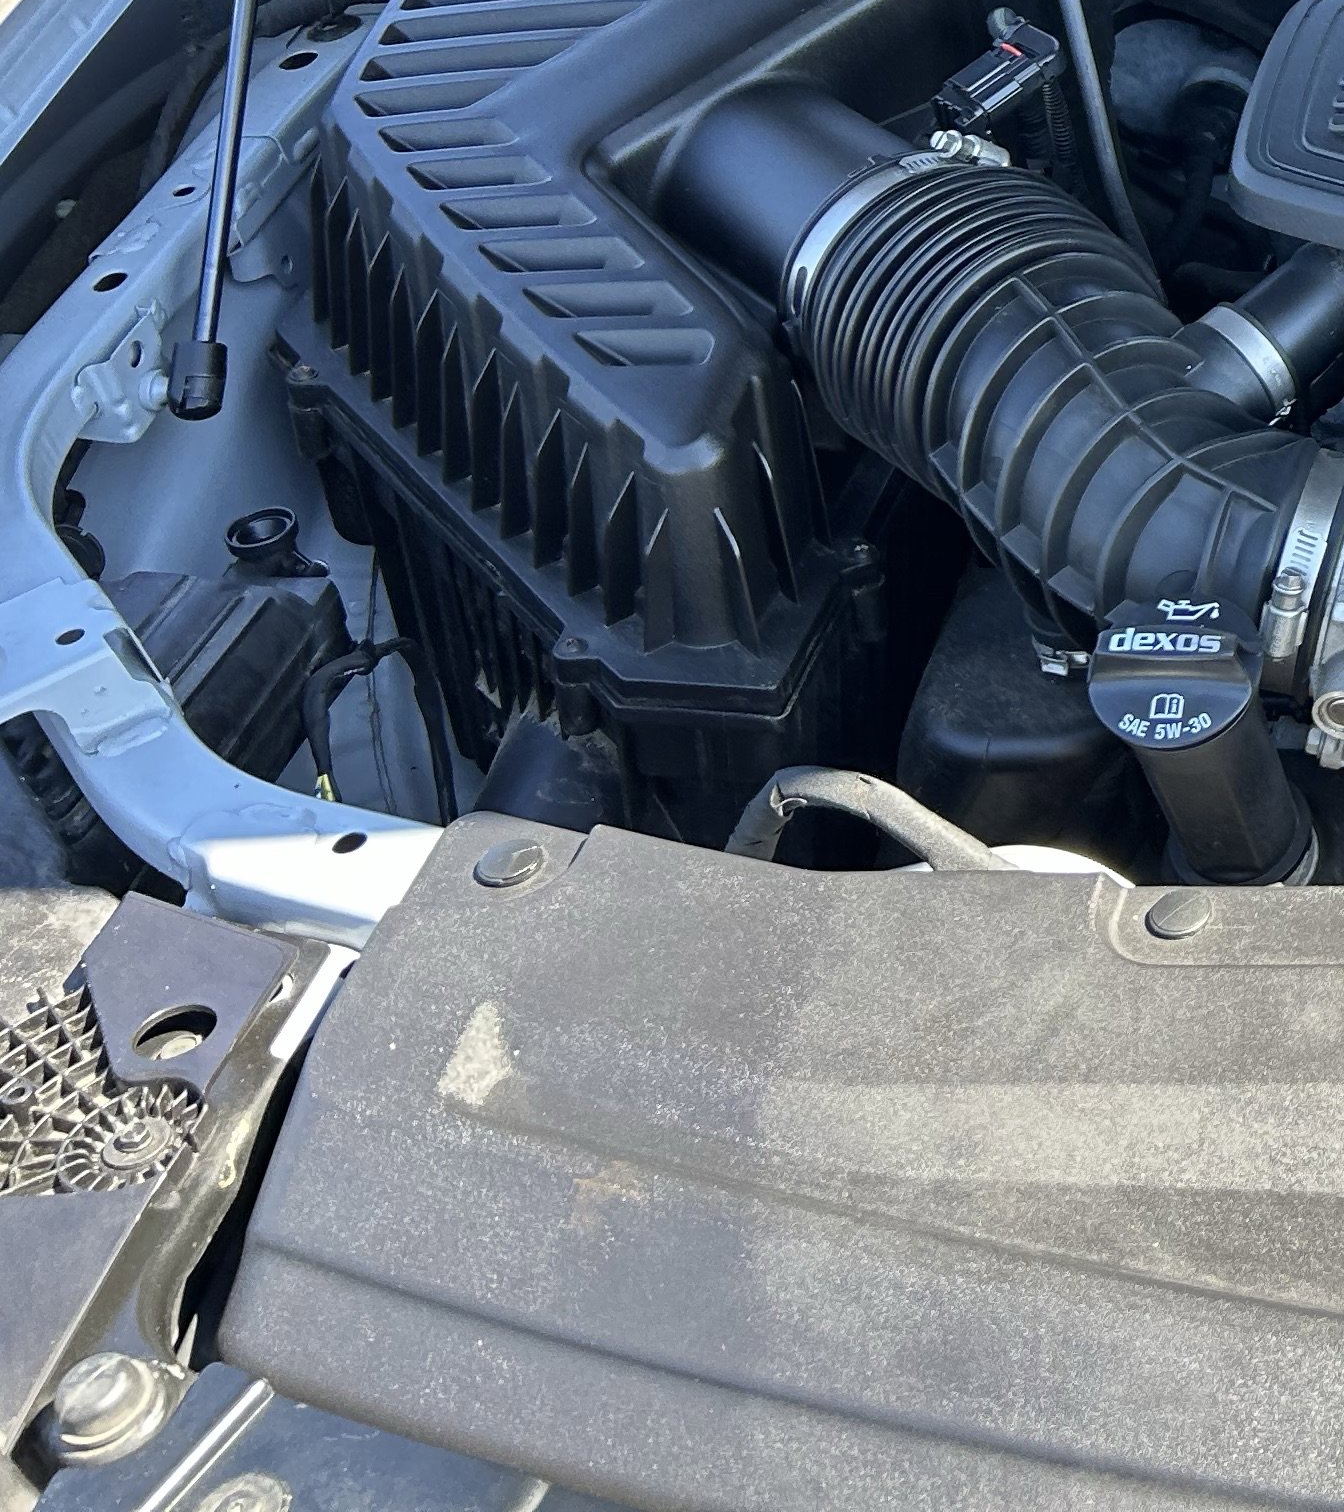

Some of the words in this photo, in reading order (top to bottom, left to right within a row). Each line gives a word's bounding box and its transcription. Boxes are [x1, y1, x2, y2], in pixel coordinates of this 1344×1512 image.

[1109, 627, 1223, 653] dexos
[1118, 713, 1149, 738] SAE
[1154, 712, 1213, 740] 5W-30
